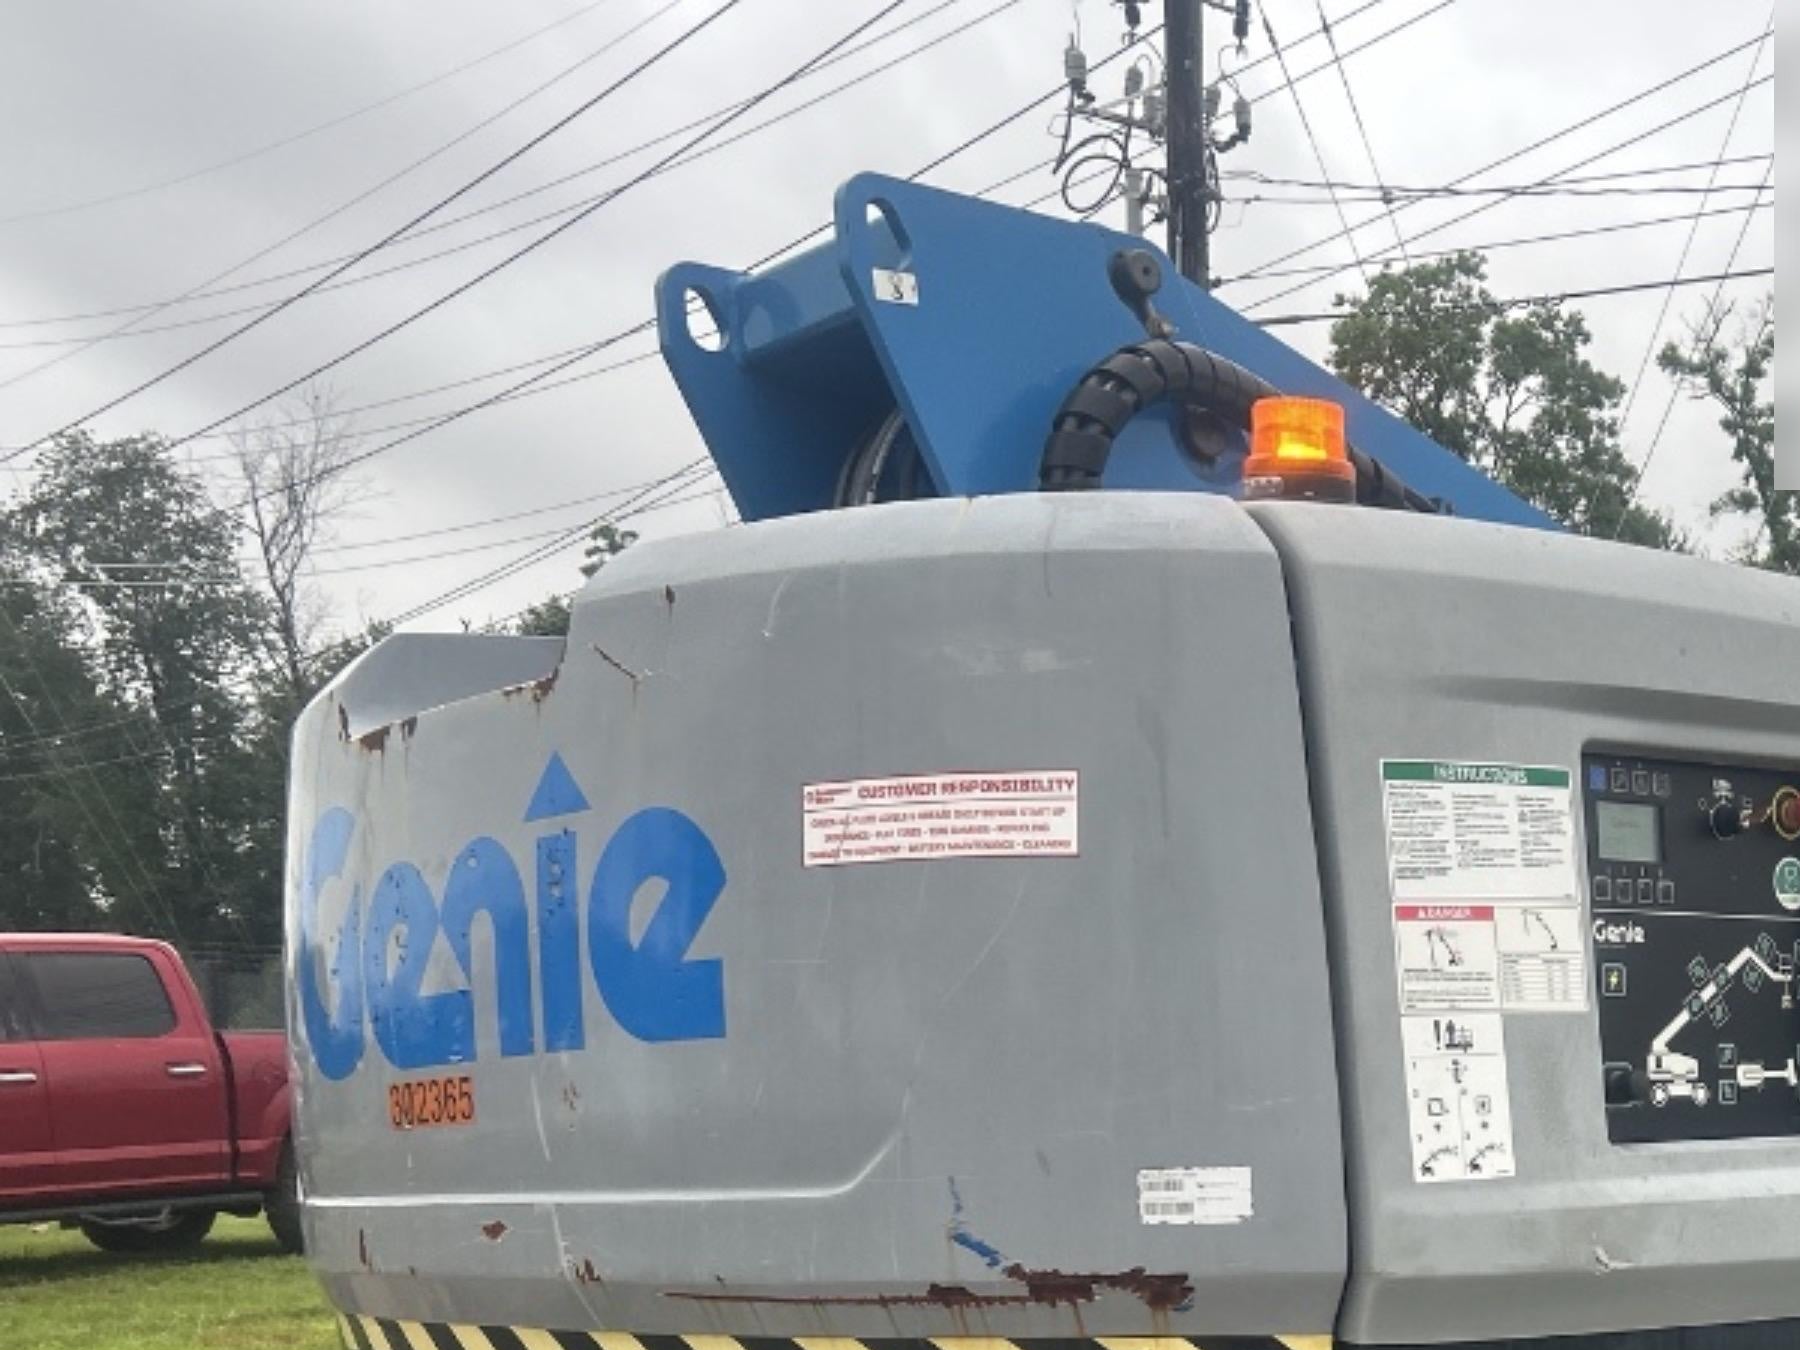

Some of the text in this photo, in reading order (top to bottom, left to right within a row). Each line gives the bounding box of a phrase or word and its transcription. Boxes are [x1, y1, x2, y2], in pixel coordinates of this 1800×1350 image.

[858, 781, 937, 800] CUSTOMER
[942, 778, 1075, 796] RESPONSIBILITY
[299, 750, 727, 1081] Genie
[1592, 918, 1645, 943] Genie
[389, 1076, 474, 1126] 302365
